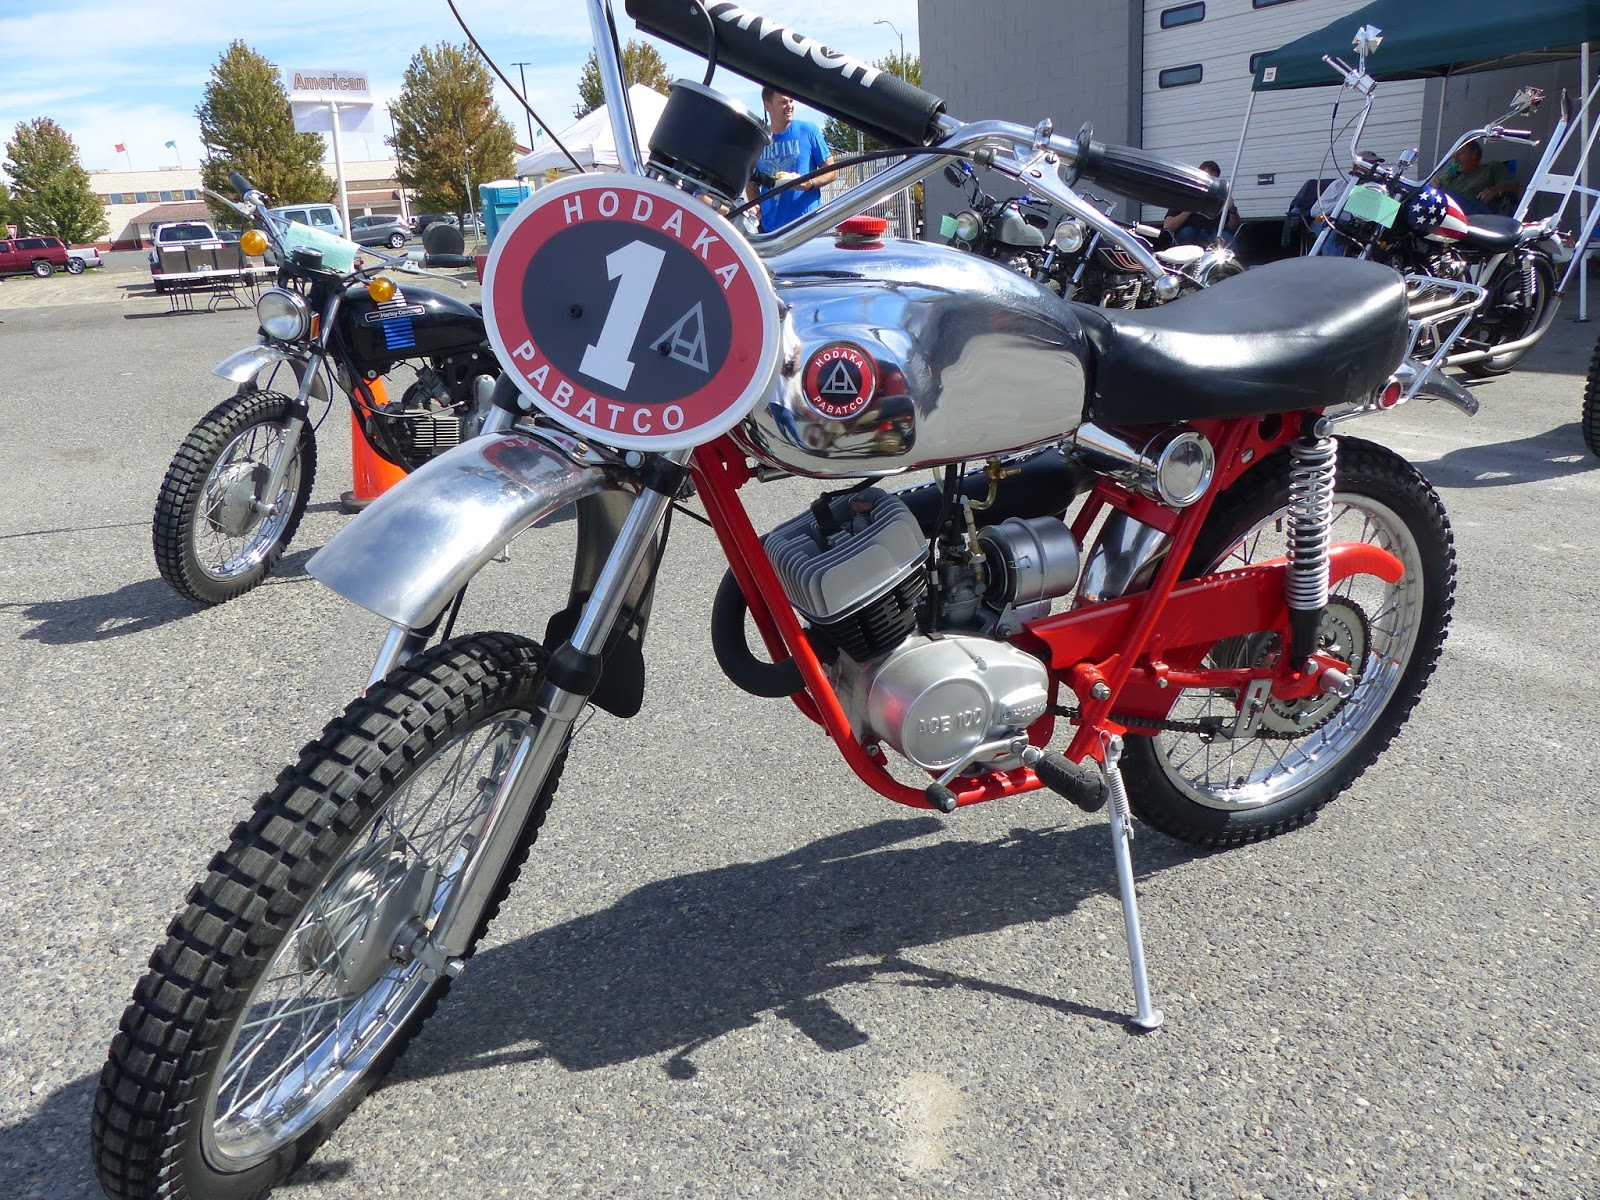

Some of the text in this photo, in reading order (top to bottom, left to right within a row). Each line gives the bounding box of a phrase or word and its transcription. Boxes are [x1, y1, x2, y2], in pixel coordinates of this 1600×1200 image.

[294, 73, 367, 91] American
[563, 191, 741, 290] HODAKA
[578, 239, 666, 391] 1
[815, 350, 864, 368] HODAKA
[512, 340, 685, 433] PABATCO
[813, 395, 864, 415] PABATCO
[919, 707, 982, 735] ACE 100
